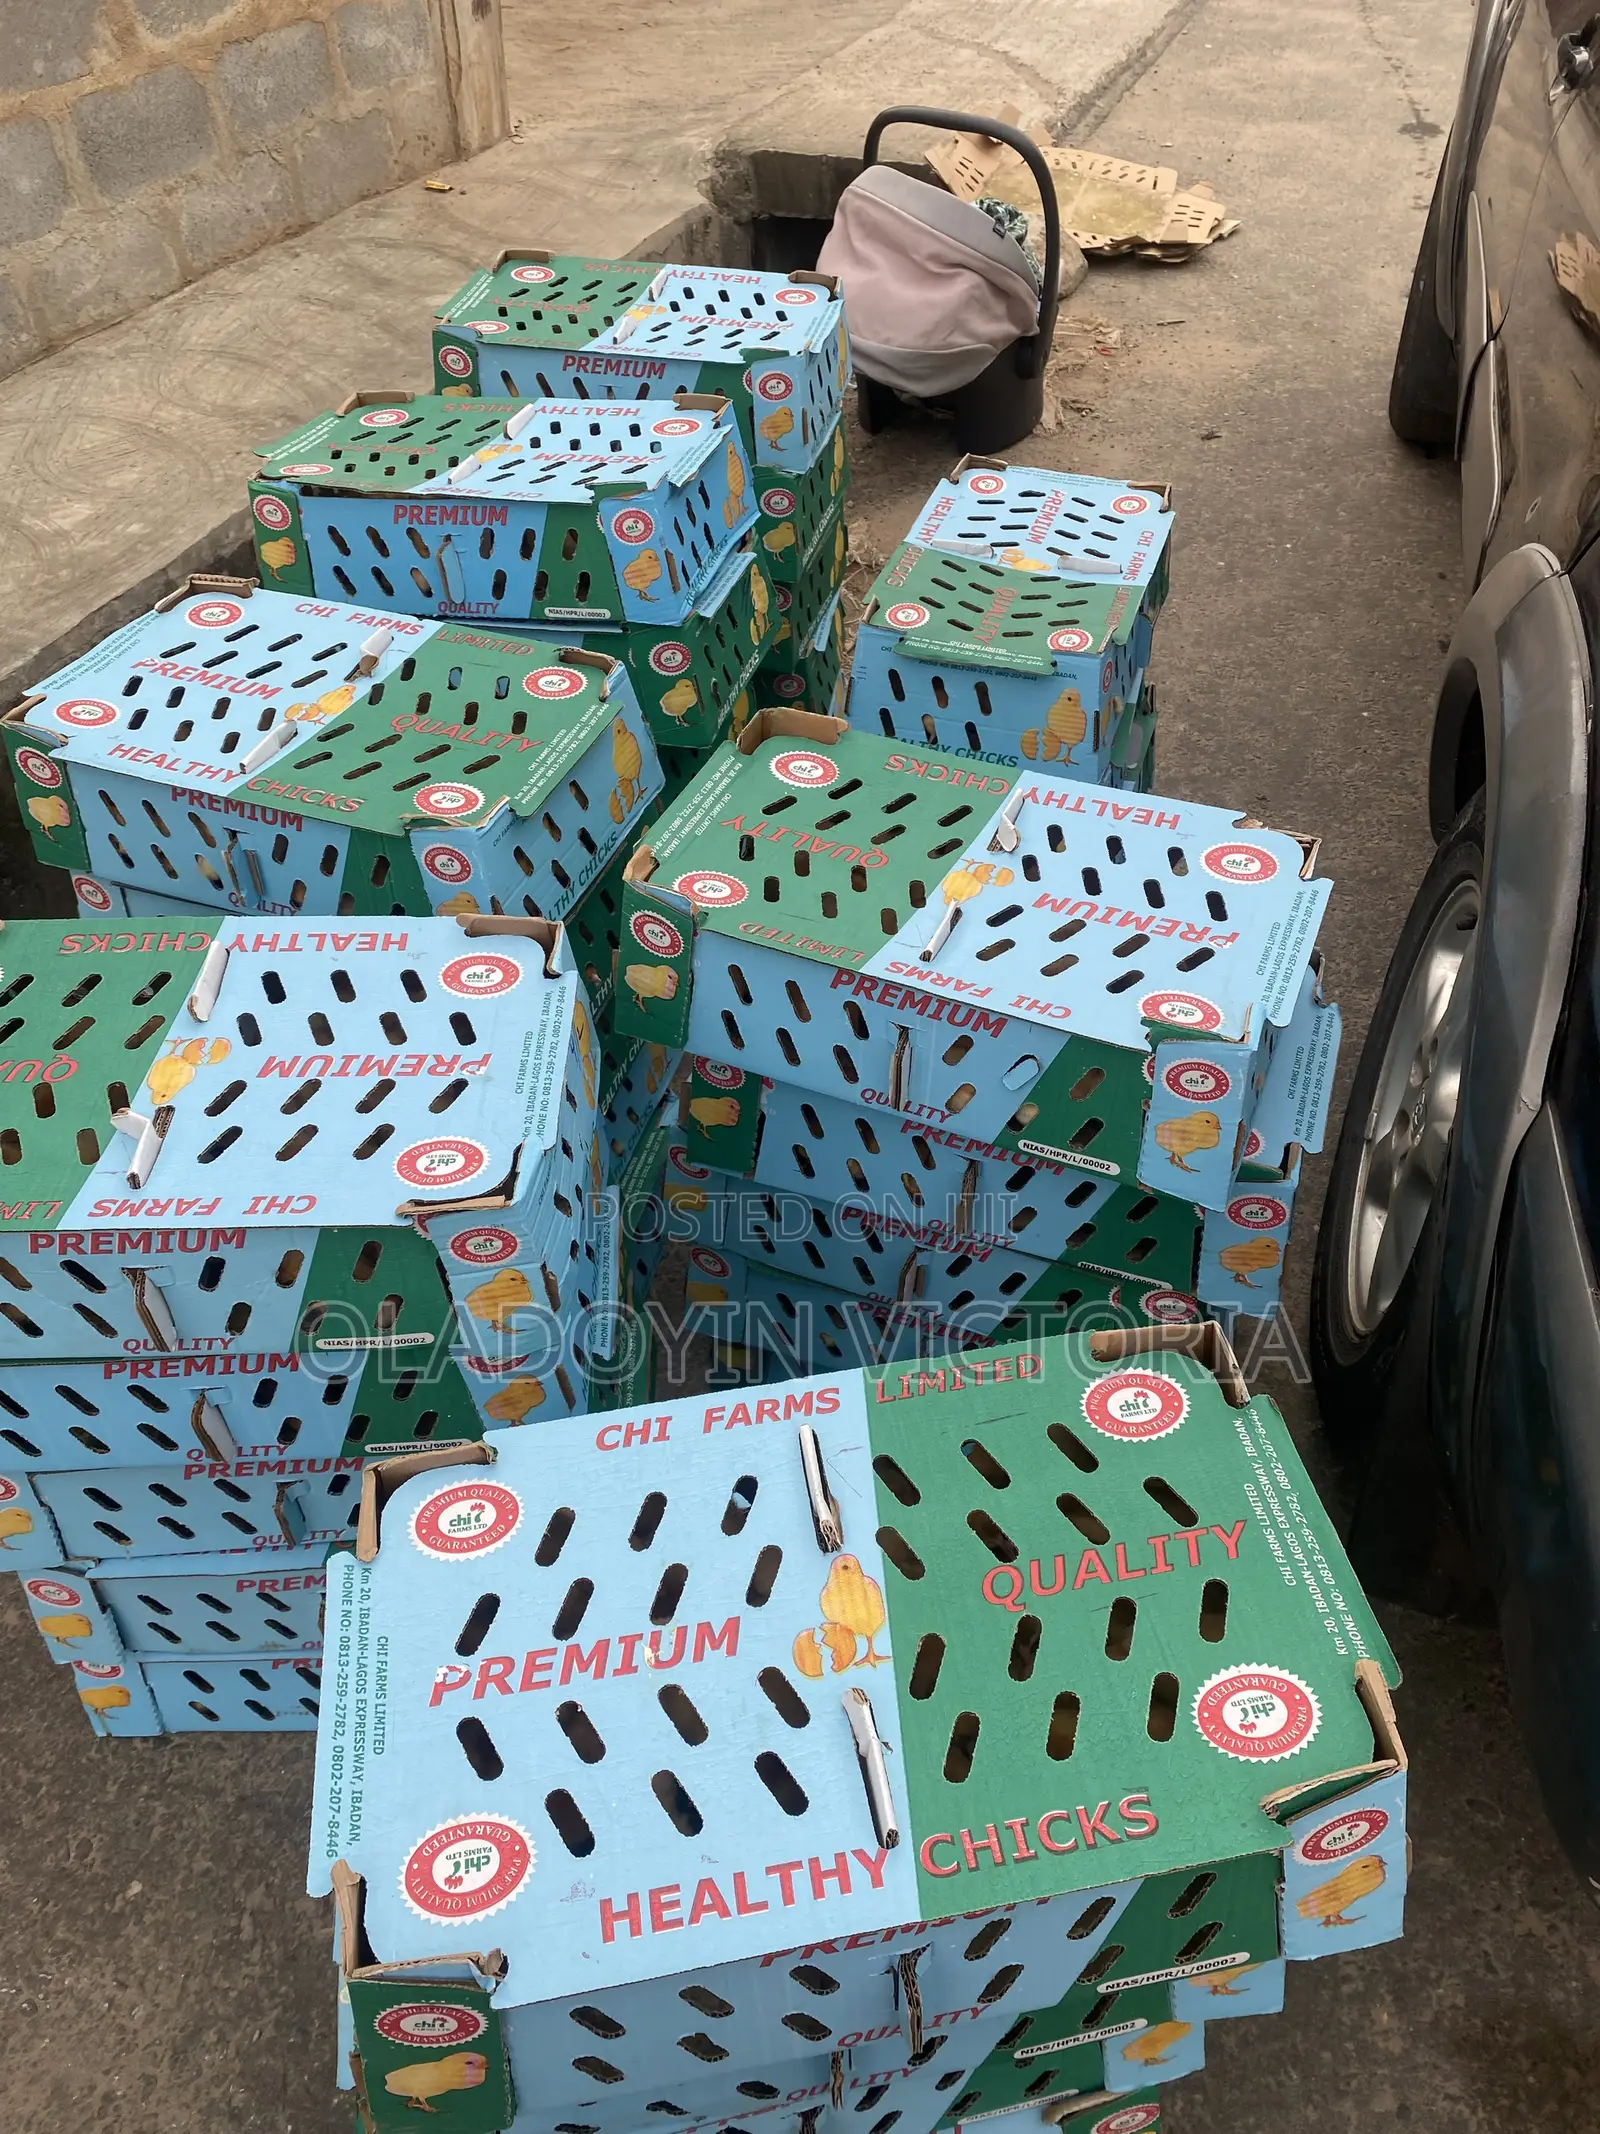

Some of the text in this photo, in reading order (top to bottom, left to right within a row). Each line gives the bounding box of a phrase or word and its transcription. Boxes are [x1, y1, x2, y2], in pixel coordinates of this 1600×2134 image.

[668, 269, 761, 285] HEALTHY
[679, 315, 795, 331] PREMIUM
[561, 354, 667, 381] PREMIUM
[537, 404, 641, 417] HEALTHY
[531, 453, 666, 465] PREMIUM
[393, 504, 509, 527] PREMIUM
[884, 495, 957, 588] HEALTHY CHICKS
[1132, 529, 1156, 548] CHI
[972, 488, 1066, 644] PREMIUM QUALITY
[1121, 550, 1148, 582] FARMS
[438, 600, 500, 616] QUALITY
[294, 602, 535, 656] CHI FARMS LIMITED
[130, 657, 545, 753] PREMIUM QUALITY
[954, 746, 1020, 769] CHICKS
[106, 743, 365, 813] HEALTHY CHICKS
[882, 753, 1182, 830] HEALTHY CHICKS
[170, 785, 304, 832] PREMIUM
[578, 830, 618, 887] CHICKS
[1211, 865, 1265, 880] GUARANTEED
[719, 813, 1241, 949] PREMIUM QUALITY
[58, 931, 409, 955] HEALTHY CHICKS
[1256, 921, 1281, 976] CHI FARMS LIMITED
[1270, 888, 1319, 1019] PHONE 0813-259-2782, 0802-207-8446
[466, 971, 485, 980] chi
[738, 920, 1073, 1021] CHI FARMS LIMITED
[451, 981, 509, 994] GUARANTEED
[829, 968, 1009, 1039] PREMIUM
[526, 990, 554, 1113] IBADAN-LAGOS EXPRESSWAY, IBADAN,
[544, 985, 567, 1096] 0813-259-2782, 0802-207-8446
[255, 1052, 494, 1079] PREMIUM
[514, 1030, 534, 1095] CHI FARMS LIMITED
[1168, 1063, 1227, 1085] PREMIUM QUALITY
[1294, 1045, 1305, 1073] LIMITED
[860, 1087, 955, 1125] QULITY
[1173, 1085, 1222, 1100] GUARANTEED
[1304, 1120, 1316, 1143] PHONE
[410, 1142, 475, 1157] GUARANTEED
[900, 1119, 1066, 1177] PREMIUM
[1022, 1141, 1112, 1173] NIAS/HPR/L/00002
[87, 1194, 317, 1218] CHI FARMS
[28, 1227, 248, 1256] PREMIUM
[840, 1205, 994, 1263] PREMIUM
[122, 1337, 237, 1354] QULITY
[323, 1336, 427, 1347] NIAS/HPR/L/00002
[102, 1352, 300, 1380] PREMIUM
[594, 1353, 1044, 1452] CHI FARMS LIMITED
[1089, 1376, 1177, 1412] PREMIUM QUALITY
[1118, 1398, 1141, 1413] chi
[1104, 1410, 1176, 1435] GUARANTEED
[183, 1456, 365, 1481] PREMIUM
[186, 1445, 289, 1462] QLITY
[420, 1487, 515, 1525] PREMIUM QUALITY
[448, 1511, 472, 1528] chi
[428, 1524, 506, 1551] GUARANTEED
[447, 1525, 473, 1535] FARMS
[1232, 1417, 1349, 1656] Km 20, IBADAN-LAGOS EXPRESSWAY, IBADAN,
[1243, 1483, 1297, 1587] CHI FARMS LIMITED
[1286, 1492, 1336, 1586] 0813-259-2782,
[428, 1518, 1248, 1709] PREMIUM QUALITY
[1330, 1588, 1349, 1612] NO:
[1340, 1613, 1371, 1658] PHONE
[346, 1567, 372, 1846] Km 20, IBADAN-LAGOS EXPRESSWAY, IBADAN,
[373, 1635, 389, 1756] CHI FARMS LIMITED
[1206, 1676, 1288, 1707] GUARANTEED
[1246, 1693, 1275, 1704] FARMS
[326, 1564, 355, 1859] PHONE NO: 0813-259-2782, 0802-207-8446
[1251, 1701, 1277, 1720] chi
[1205, 1706, 1308, 1753] PREMIUM QUALITY
[421, 1824, 512, 1857] GUARANTEED
[463, 1845, 493, 1857] FARMS
[1314, 1828, 1380, 1859] GUARANTEED
[1326, 1832, 1346, 1847] chi
[463, 1854, 492, 1875] chi
[599, 1846, 890, 1946] HEALTHY
[919, 1793, 1160, 1879] CHICKS
[409, 1858, 522, 1911] PREMIUM QUALITY
[1105, 1955, 1238, 1992] NIAS/HPR/L/00002
[414, 2020, 436, 2029] chi
[1019, 2021, 1137, 2057] NIAS/HPR/L/00002
[786, 2066, 922, 2102] QULITY
